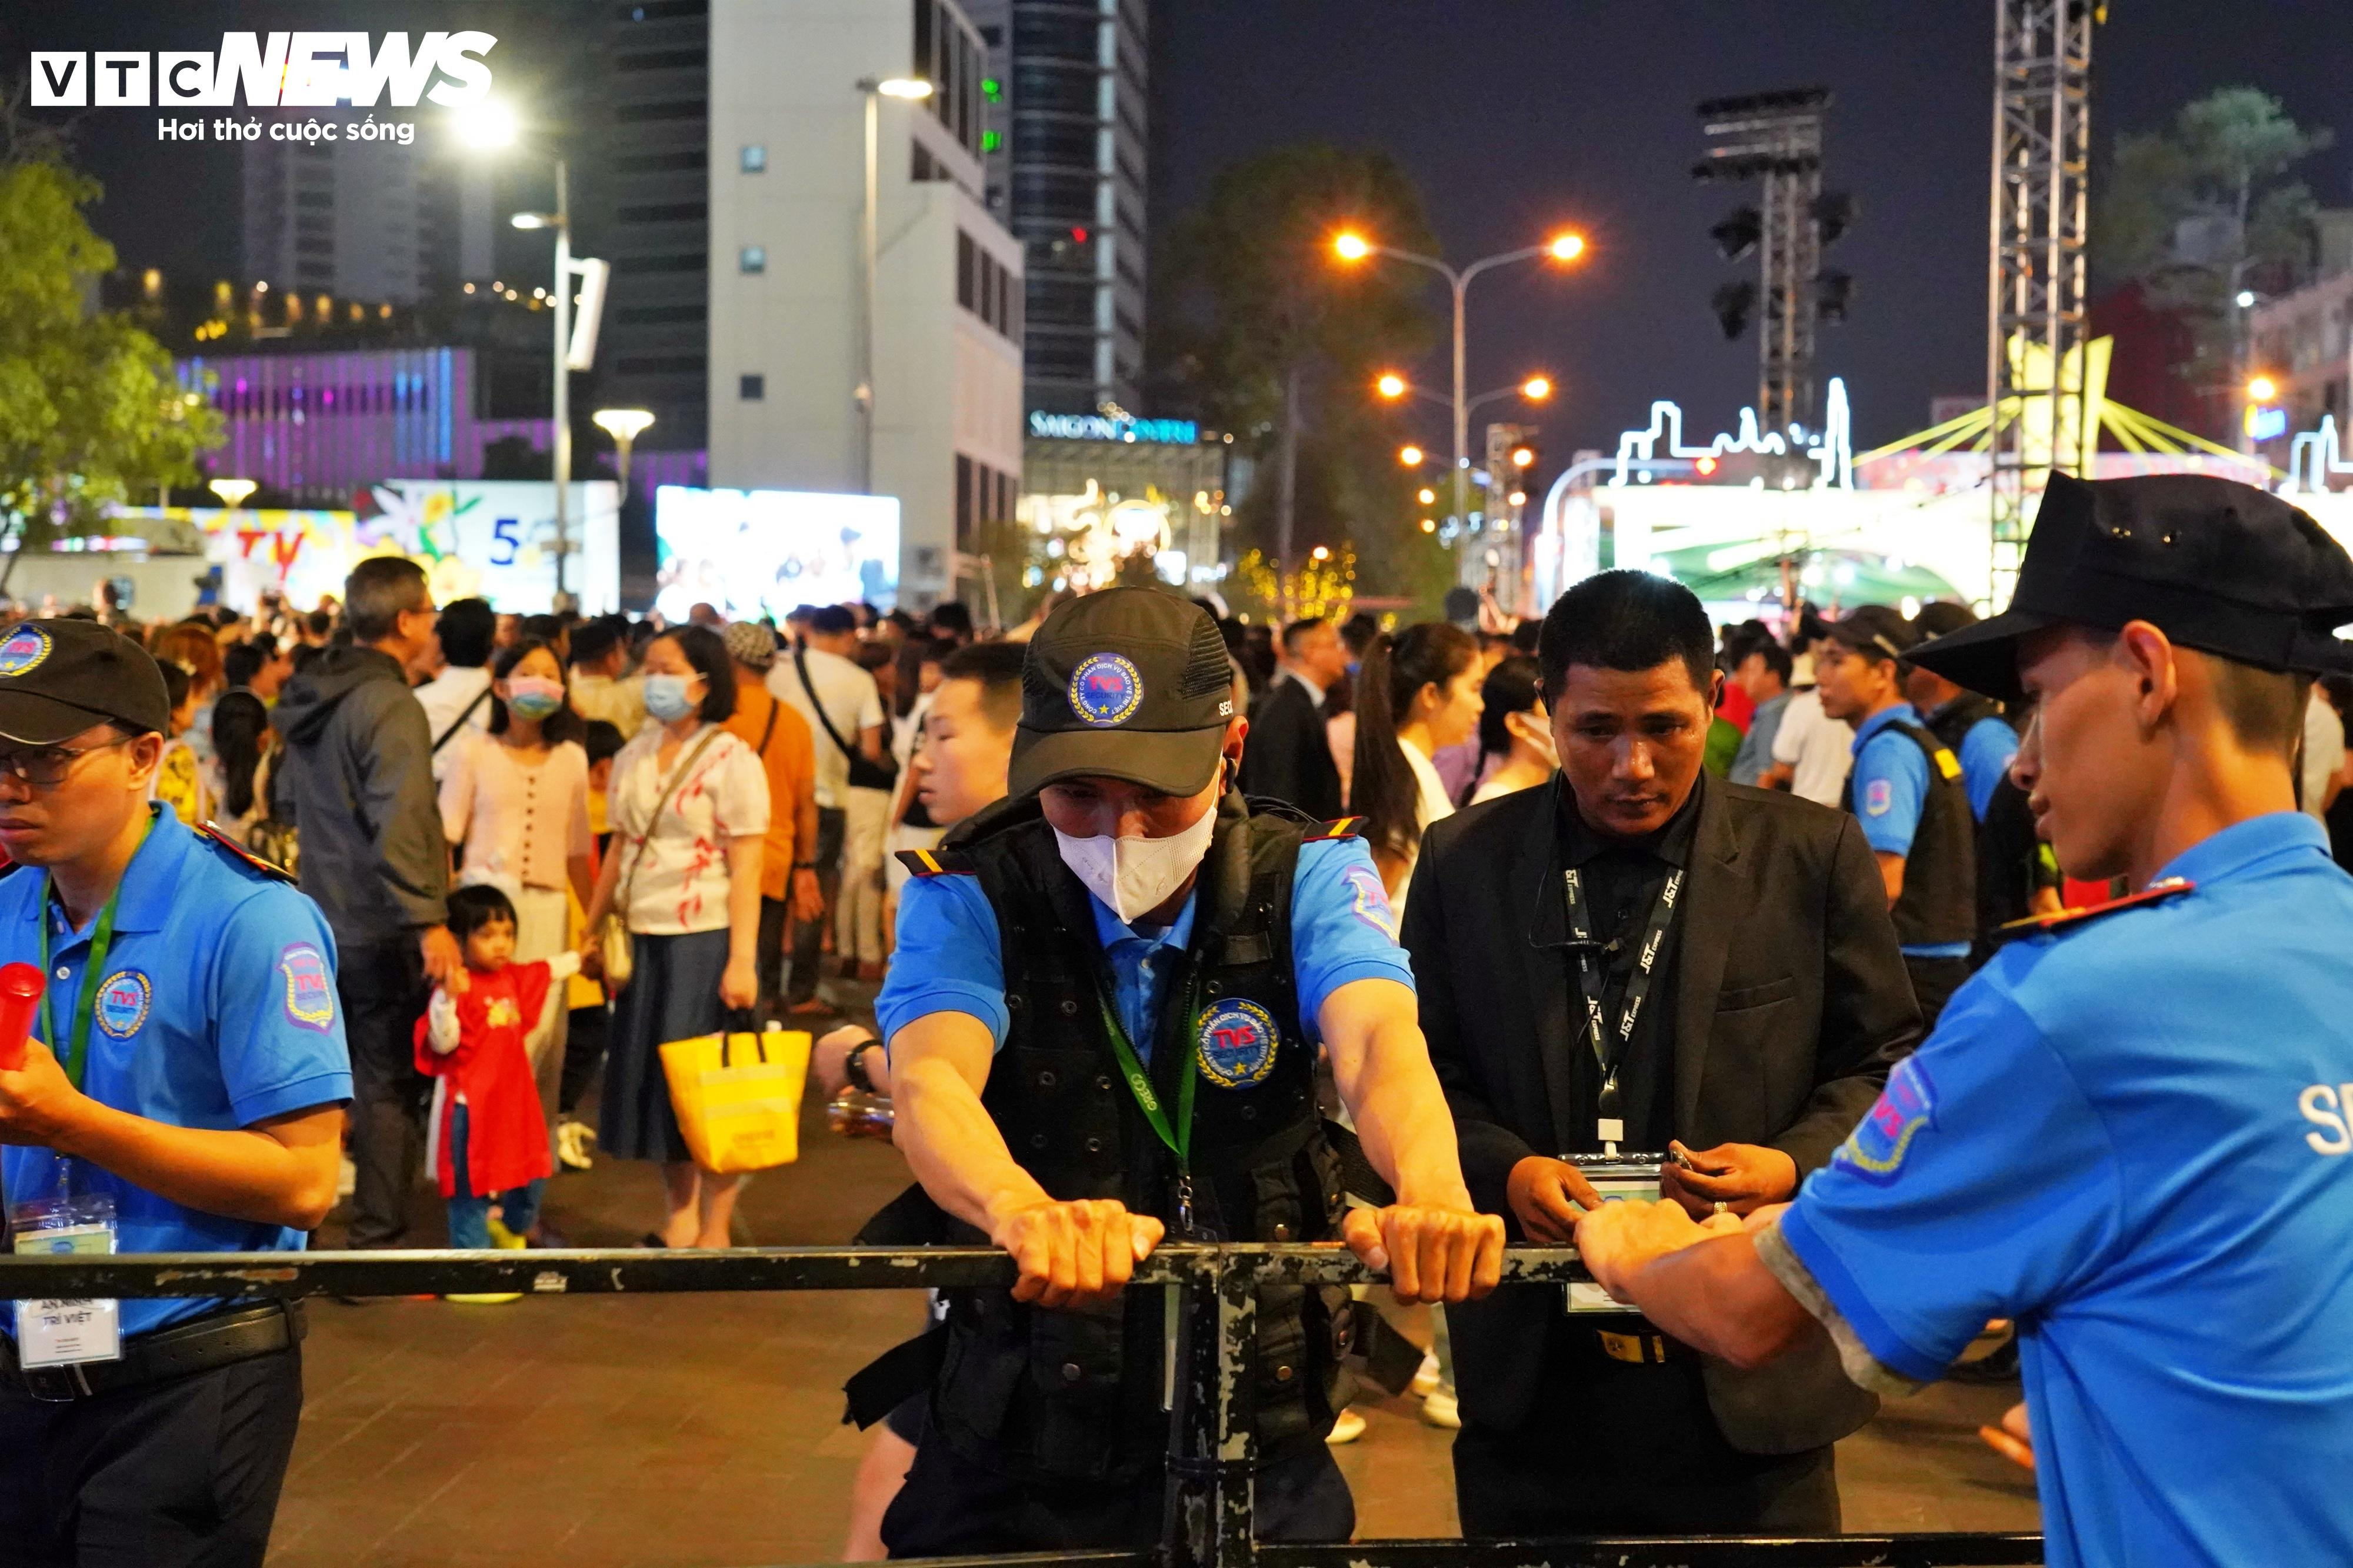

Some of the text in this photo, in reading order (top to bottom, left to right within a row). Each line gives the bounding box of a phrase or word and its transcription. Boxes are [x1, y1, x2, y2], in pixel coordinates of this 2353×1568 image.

[1088, 676, 1124, 692] TVS
[1662, 876, 1678, 908] J&T
[1640, 929, 1662, 975] J&T EXPRESS
[111, 990, 138, 1006] TVS
[1591, 1019, 1601, 1041] EXPRESS
[1619, 995, 1641, 1042] J&T EXPRESS
[1213, 1025, 1255, 1049] TVS
